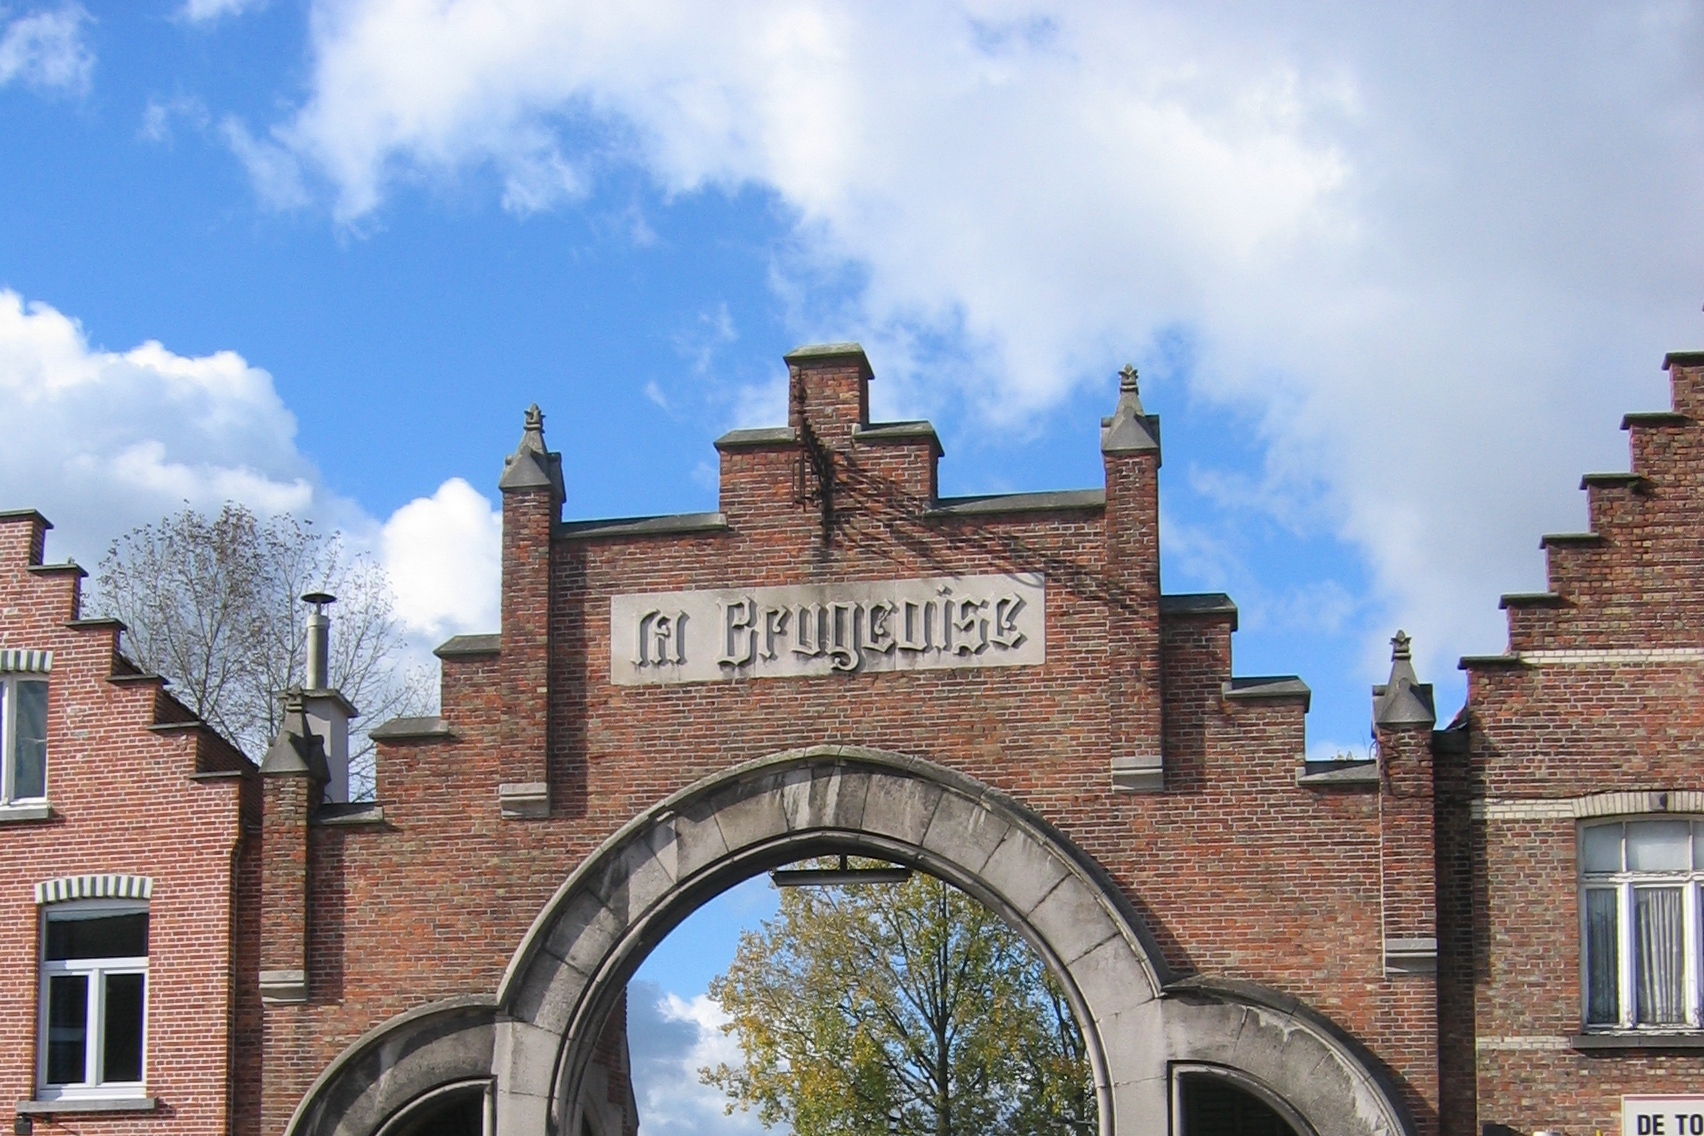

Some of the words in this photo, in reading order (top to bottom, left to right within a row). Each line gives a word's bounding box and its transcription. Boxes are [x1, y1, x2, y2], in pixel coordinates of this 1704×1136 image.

[714, 585, 1027, 672] Brugeoise
[1636, 1113, 1665, 1136] DE
[1674, 1113, 1704, 1136] TO
